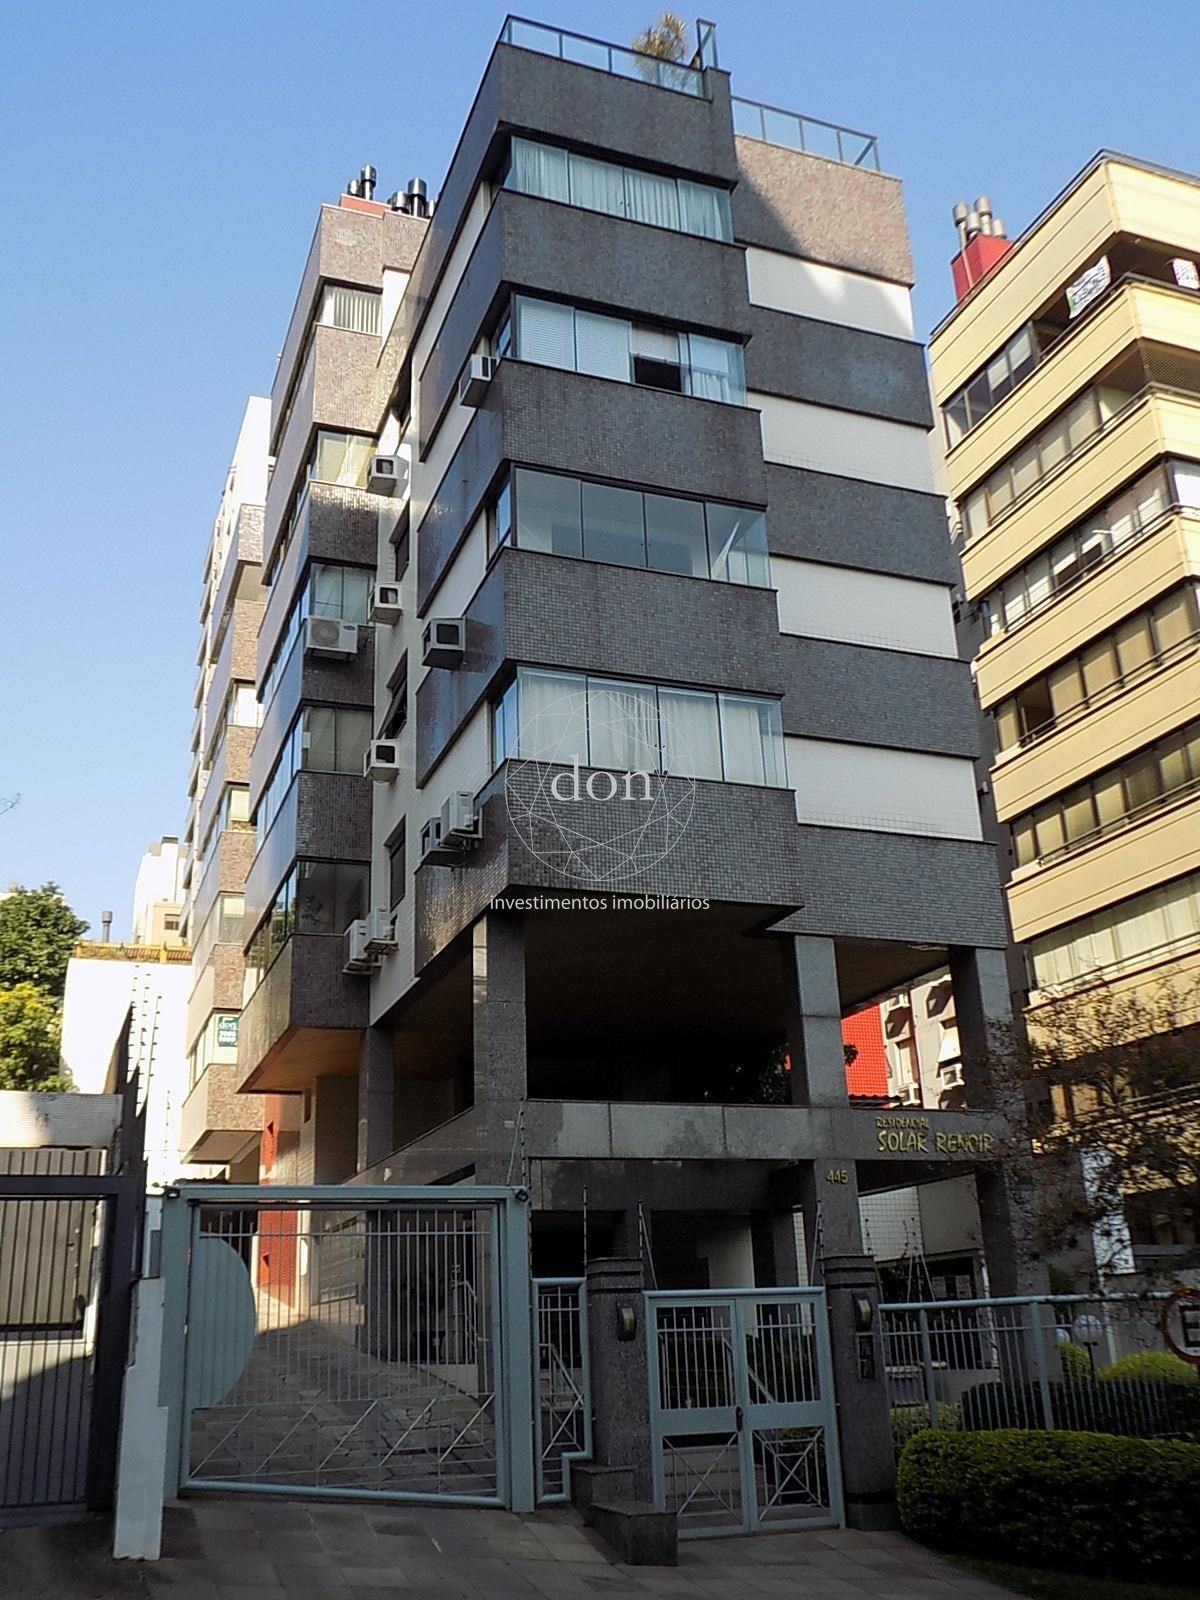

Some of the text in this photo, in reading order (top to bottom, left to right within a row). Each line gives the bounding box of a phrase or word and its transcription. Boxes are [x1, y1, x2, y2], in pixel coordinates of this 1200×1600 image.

[876, 1116, 930, 1129] RESIDENCIAL
[878, 1130, 995, 1154] SOLAR RENOIR
[826, 1170, 849, 1185] 445
